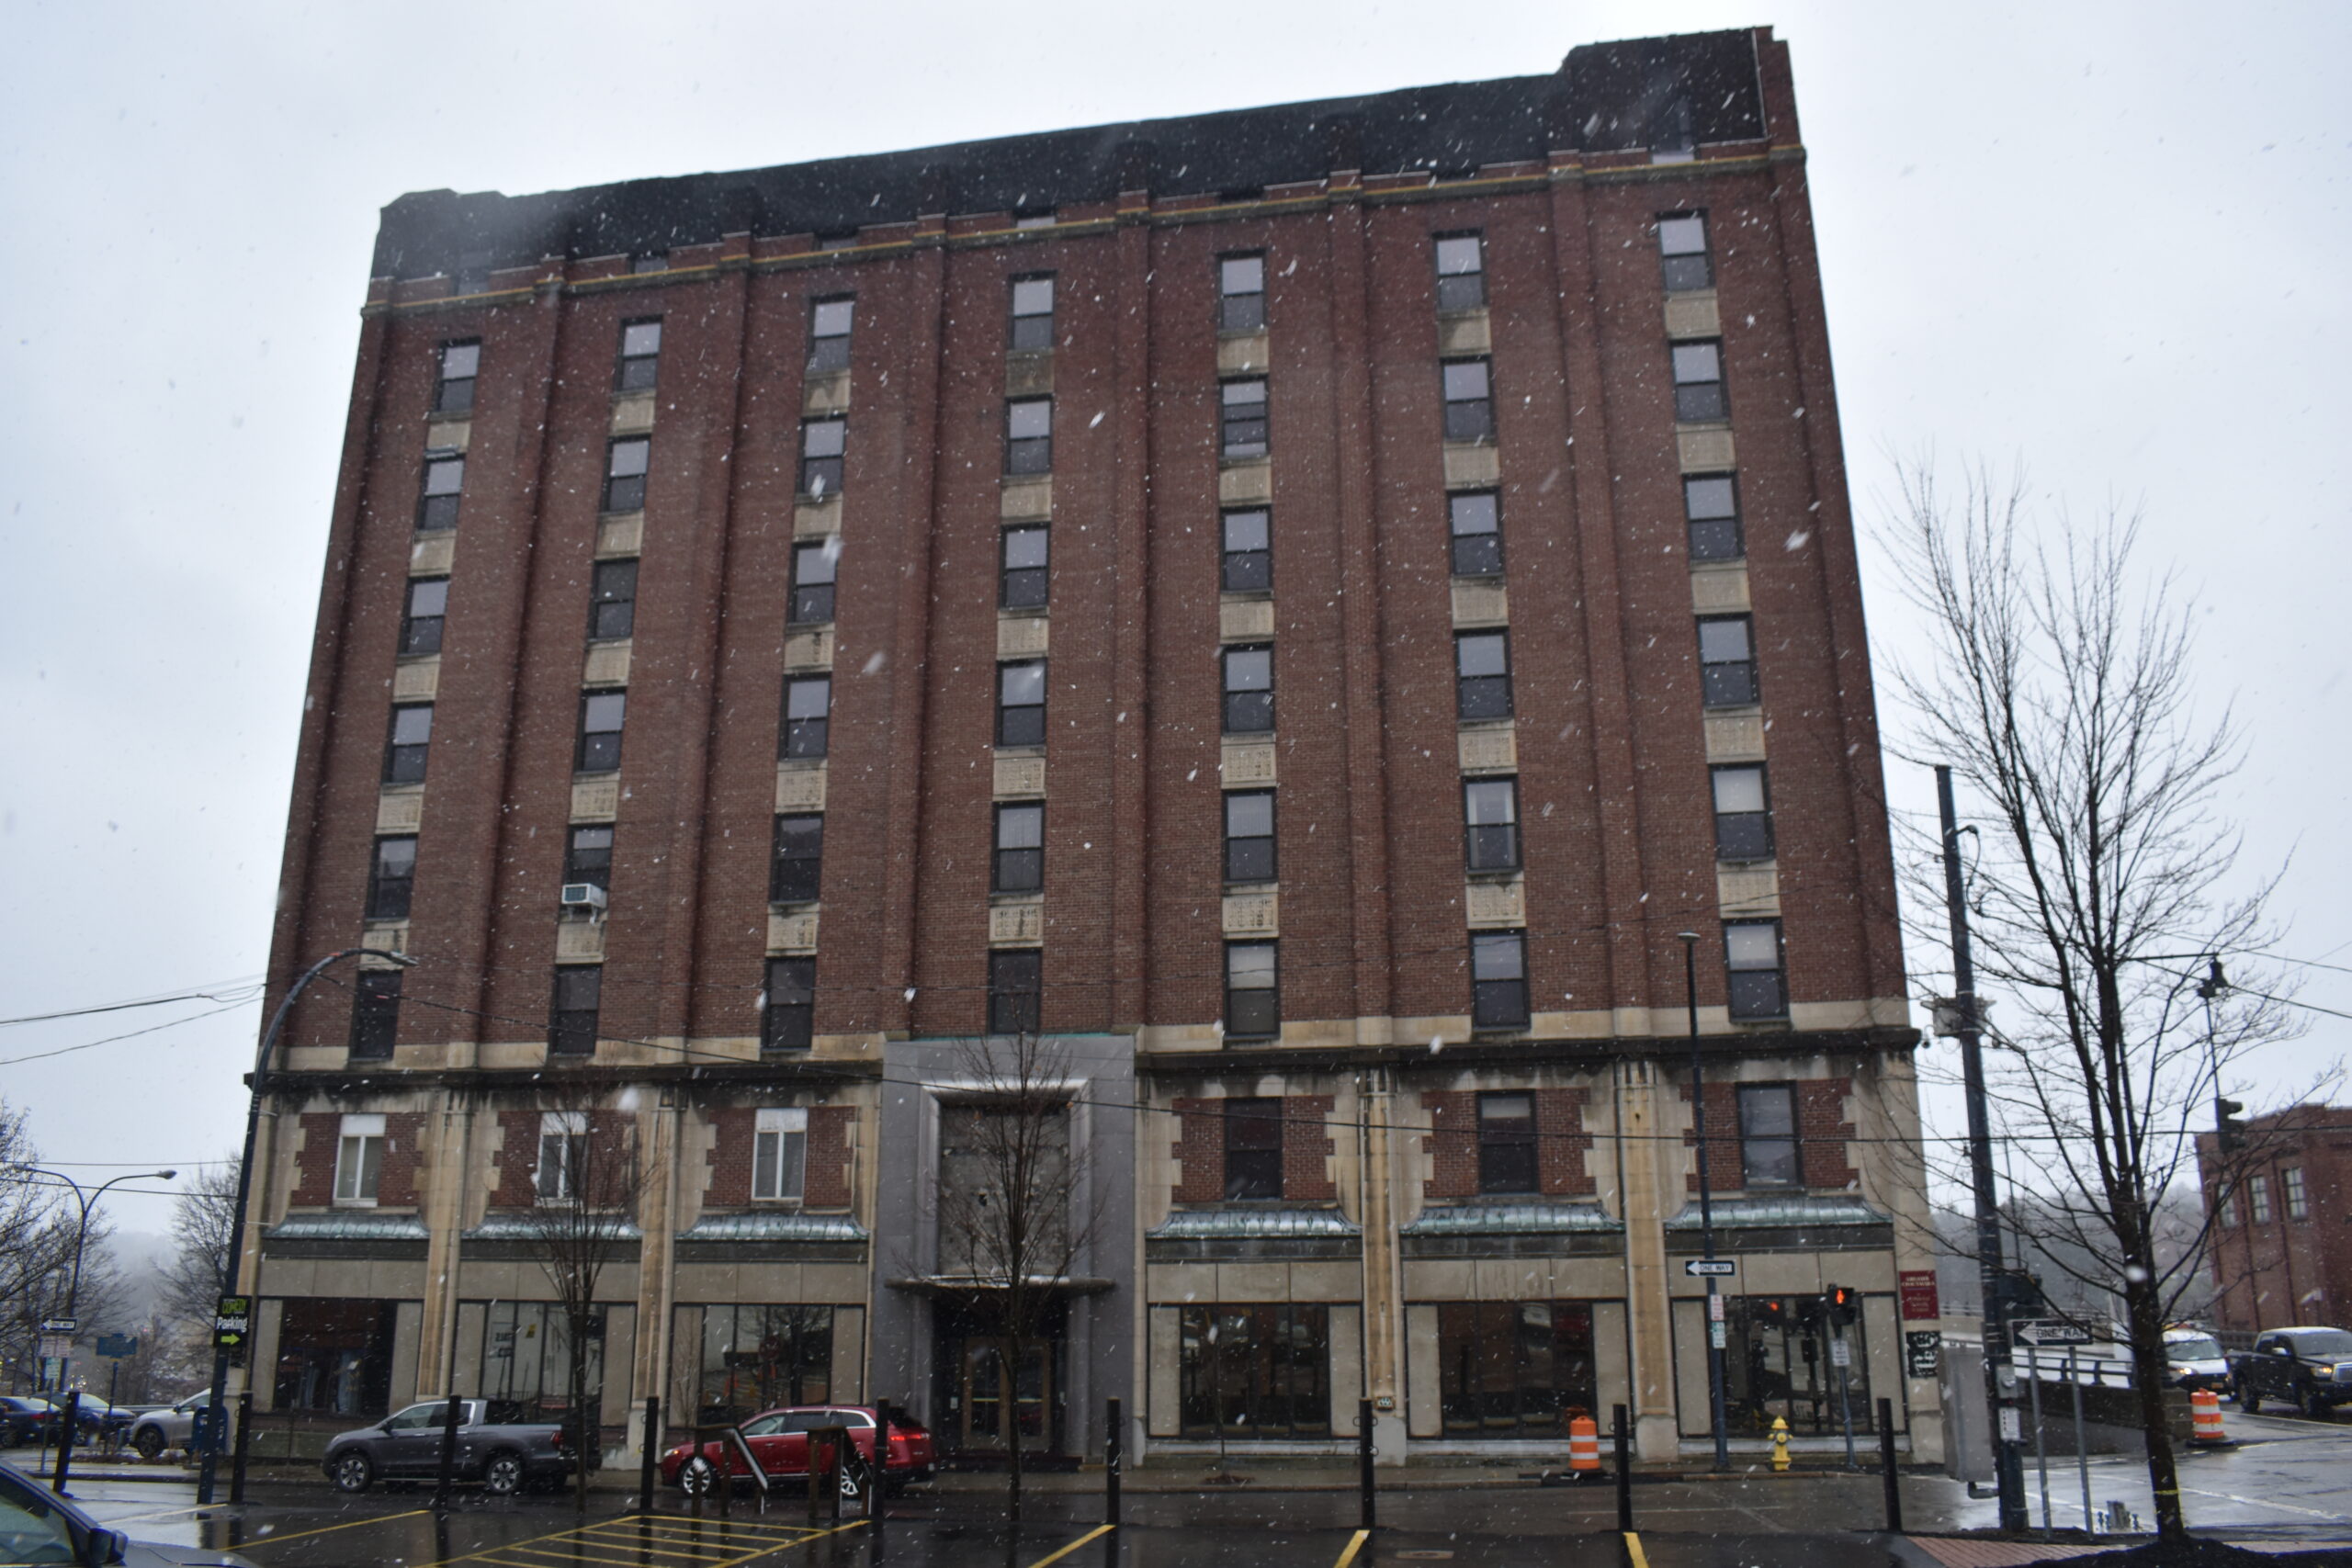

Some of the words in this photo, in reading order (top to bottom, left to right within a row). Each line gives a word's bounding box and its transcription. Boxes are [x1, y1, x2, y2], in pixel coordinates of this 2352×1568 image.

[1715, 1263, 1730, 1272] WAY
[216, 1315, 248, 1333] Parking
[2036, 1328, 2058, 1338] ONE
